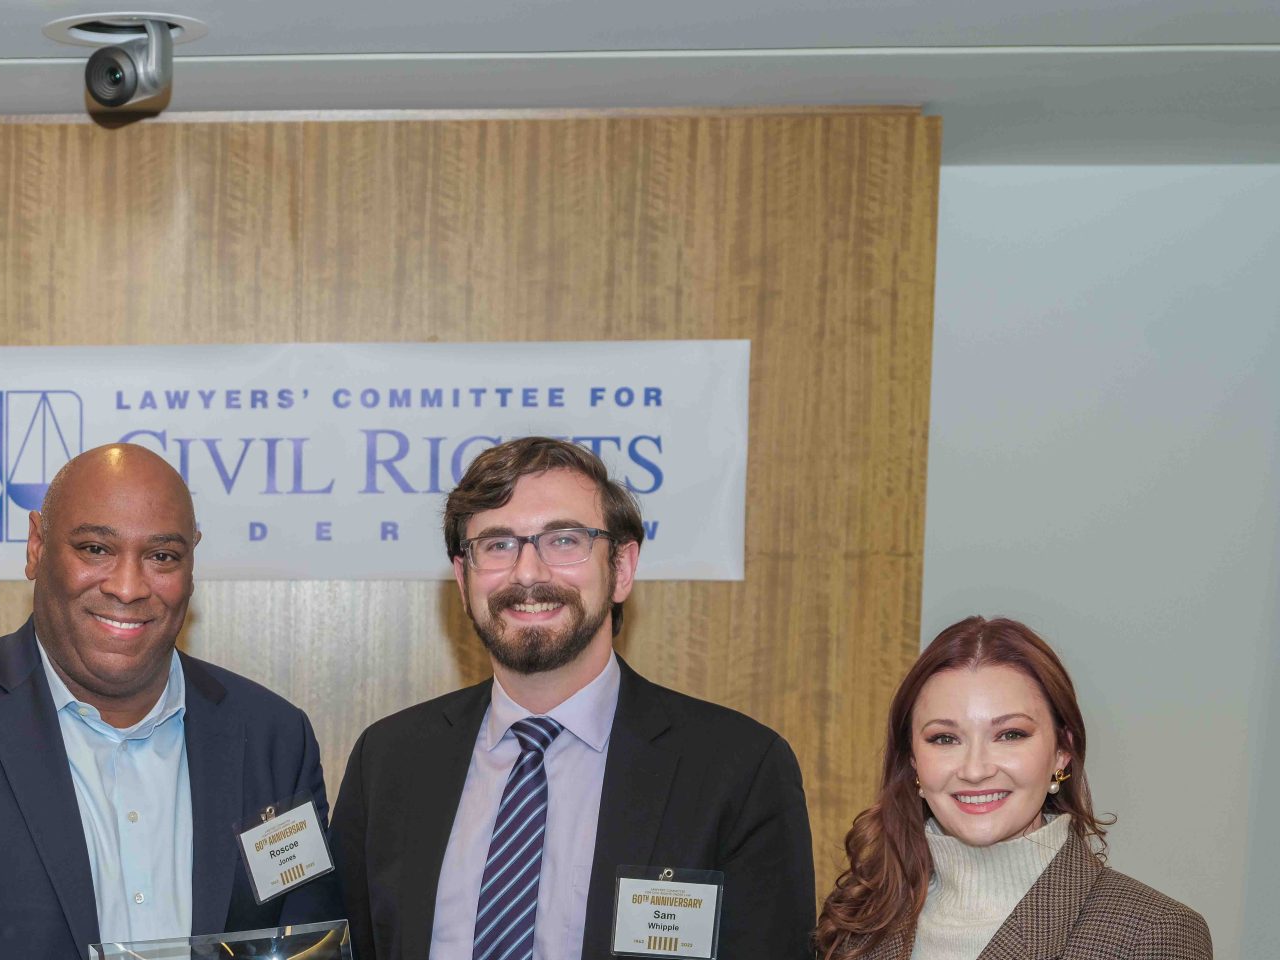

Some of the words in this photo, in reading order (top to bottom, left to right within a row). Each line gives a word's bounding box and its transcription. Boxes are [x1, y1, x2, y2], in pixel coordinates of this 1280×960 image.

[115, 388, 310, 410] LAWYERS’
[332, 386, 565, 409] COMMITTEE
[590, 386, 663, 407] FOR
[269, 821, 307, 845] ANNIVERSARY
[269, 840, 299, 859] Roscoe
[650, 896, 703, 908] ANNIVERSARY
[653, 910, 676, 920] Sam
[648, 922, 679, 932] Whipple
